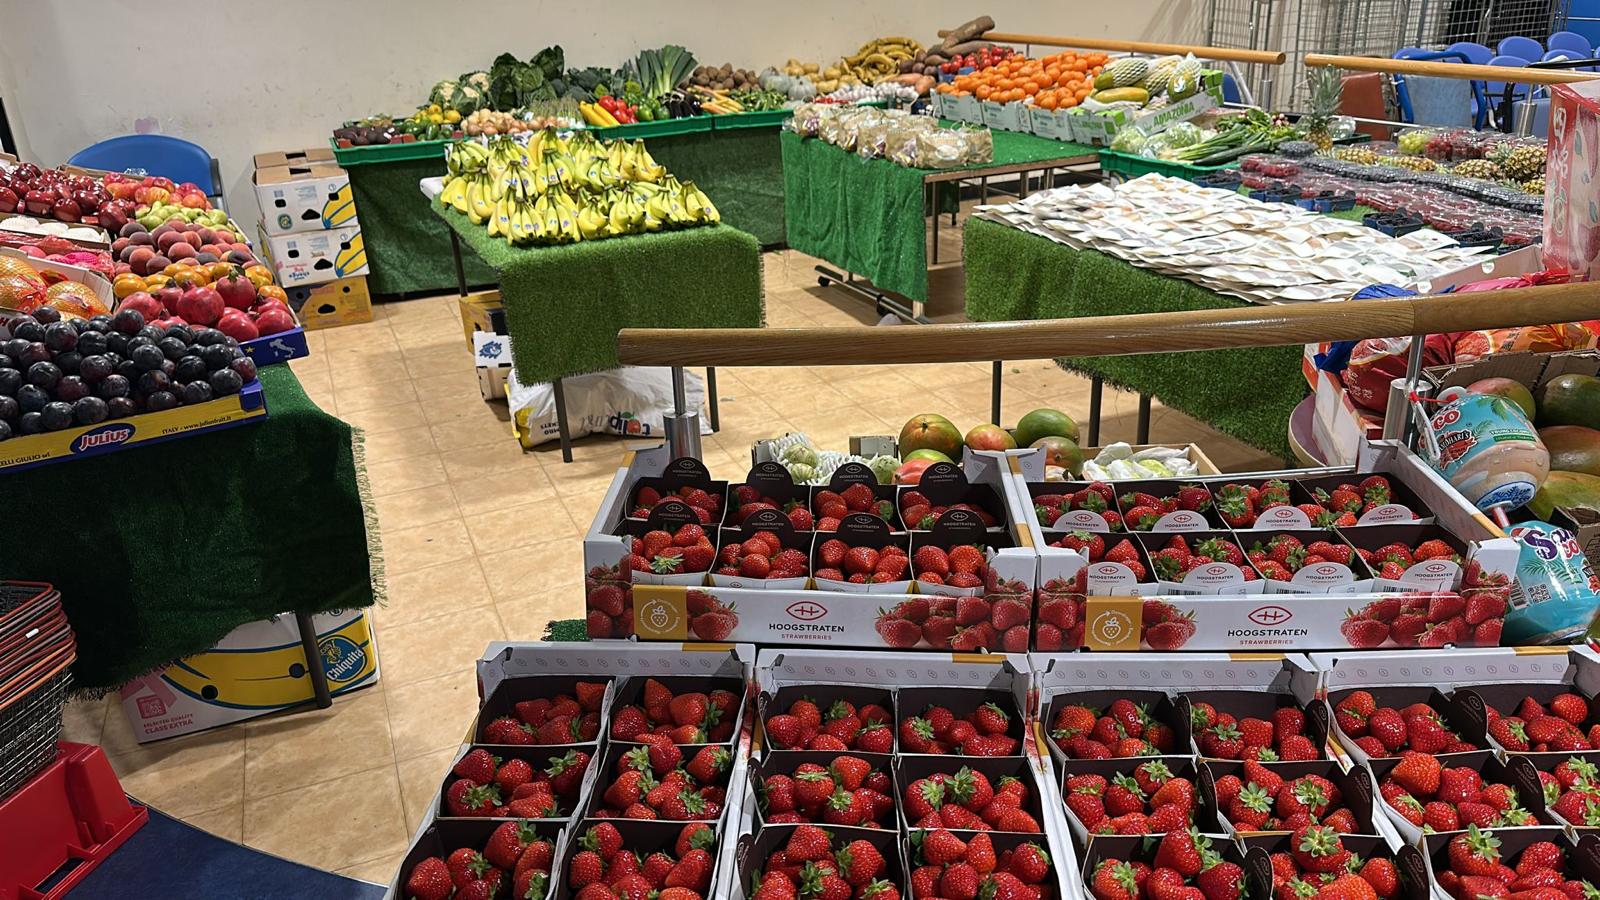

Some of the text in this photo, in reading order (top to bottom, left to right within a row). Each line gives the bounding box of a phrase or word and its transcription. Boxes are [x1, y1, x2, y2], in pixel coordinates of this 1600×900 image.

[1153, 102, 1195, 126] AMAZONIA
[15, 454, 41, 463] GIULIO
[769, 623, 845, 632] HOOGSTRATEN
[1227, 629, 1308, 637] HOOGSTRATEN
[326, 649, 364, 680] Chiquita
[145, 719, 193, 734] CLASS EXTRA
